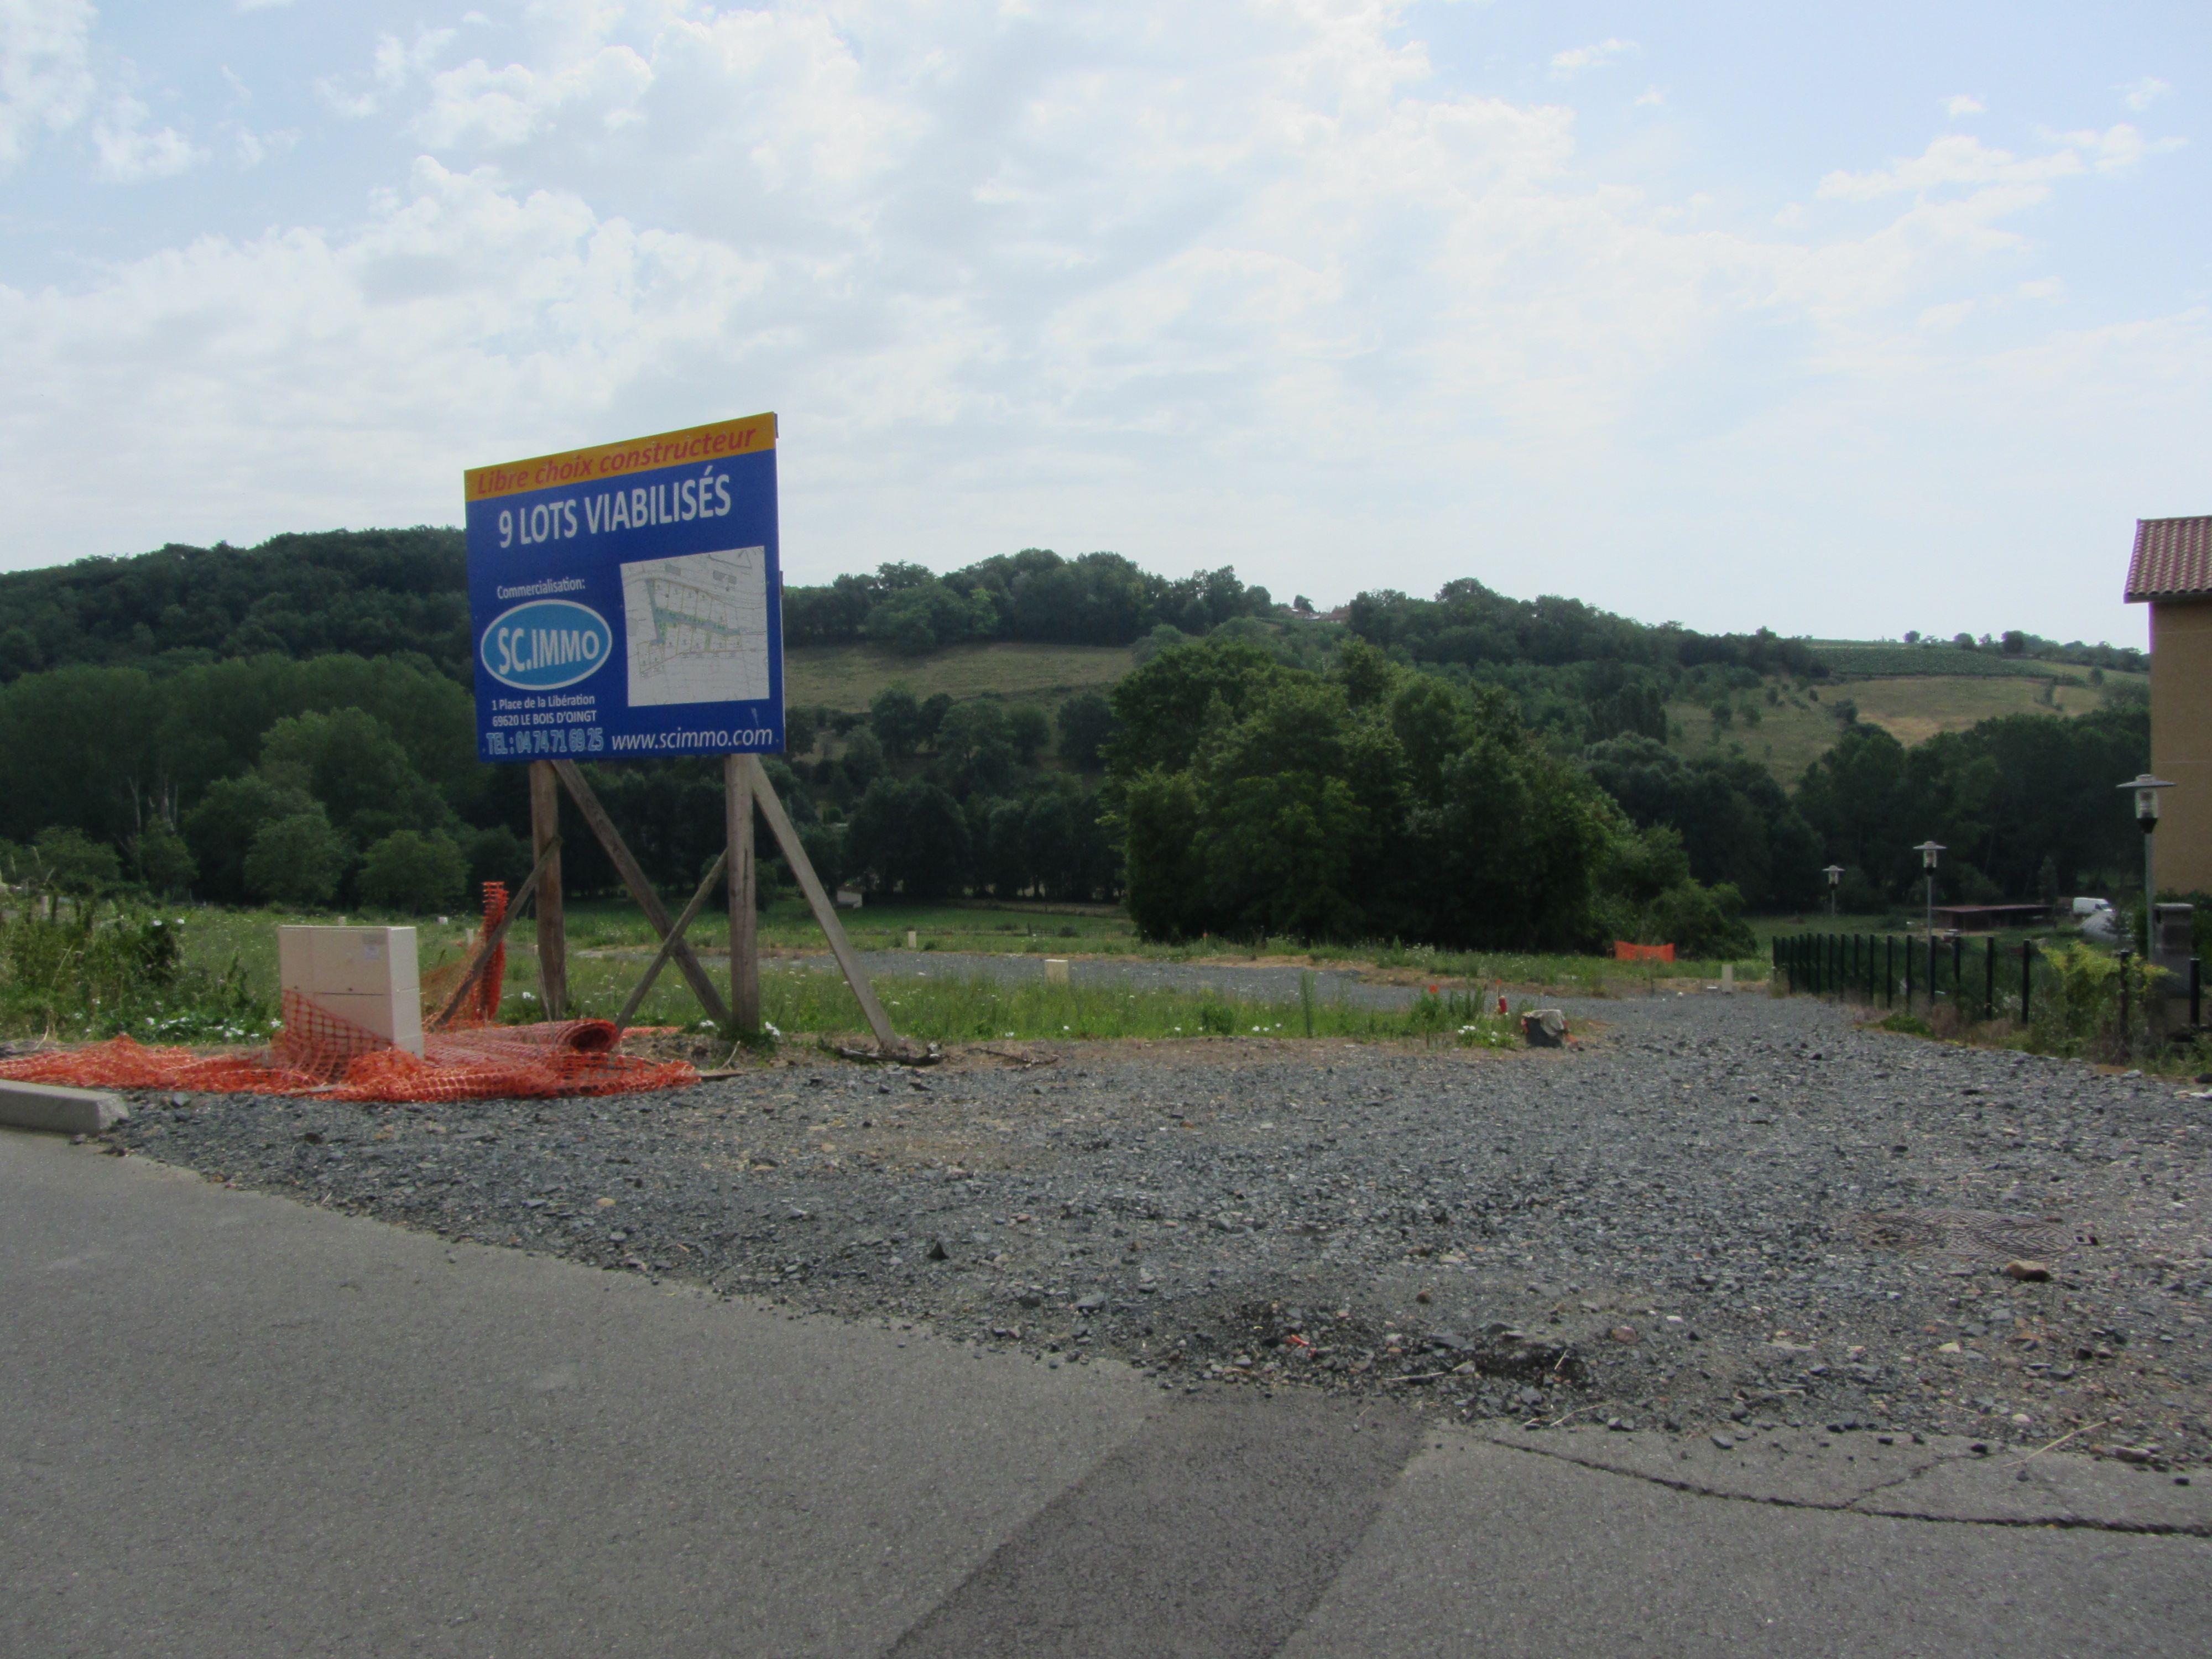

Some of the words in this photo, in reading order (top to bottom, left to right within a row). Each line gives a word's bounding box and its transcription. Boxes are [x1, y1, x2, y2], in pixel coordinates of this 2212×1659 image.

[478, 469, 527, 495] Libre
[535, 455, 593, 484] choix
[599, 426, 756, 473] constructeur
[499, 510, 512, 549] 9
[520, 499, 577, 545] LOTS
[585, 465, 731, 535] VIABILISÉS
[497, 576, 586, 599] Commercialisation:
[492, 700, 497, 710] 1
[499, 698, 522, 709] Place
[525, 697, 535, 708] de
[538, 696, 546, 707] la
[548, 693, 595, 707] Libération
[492, 714, 519, 727] 69620
[521, 714, 531, 725] LE
[533, 712, 554, 724] BOIS
[515, 731, 531, 754] 04
[533, 730, 550, 753] 74
[550, 729, 567, 753] 71
[587, 727, 604, 752] 25
[612, 727, 773, 751] www.scimmo.com
